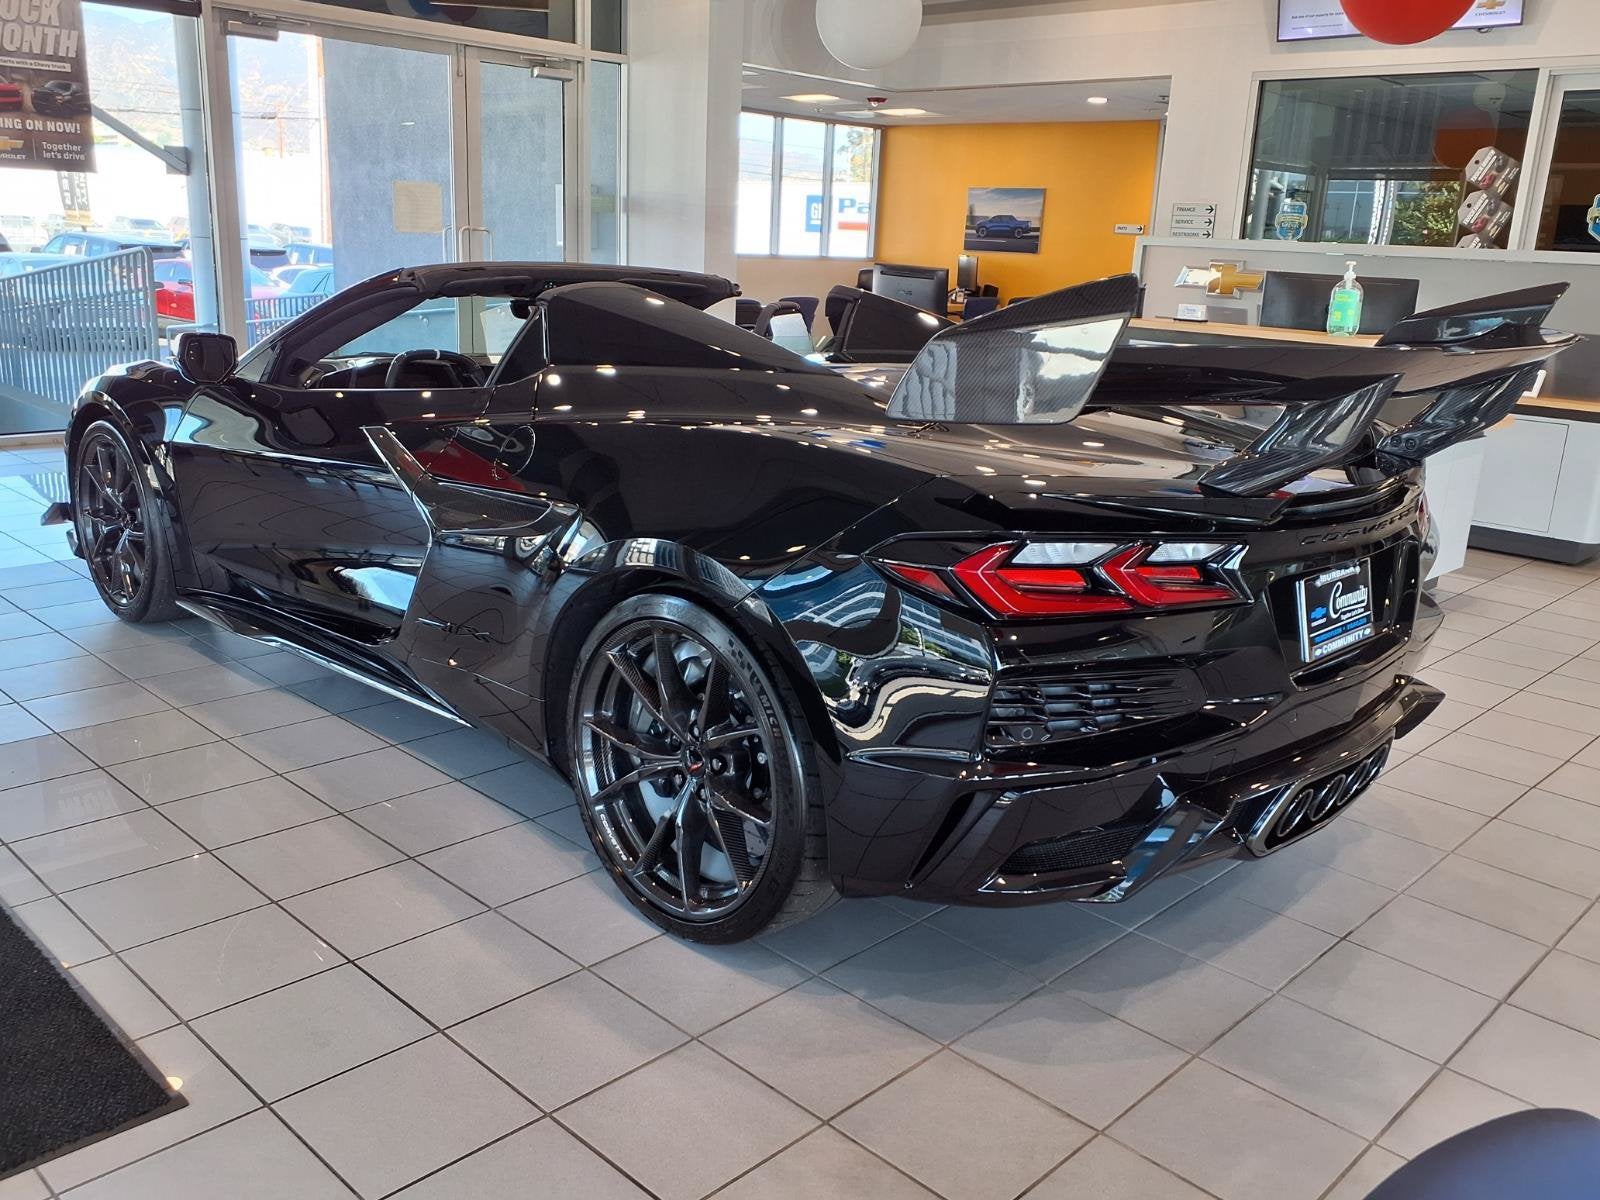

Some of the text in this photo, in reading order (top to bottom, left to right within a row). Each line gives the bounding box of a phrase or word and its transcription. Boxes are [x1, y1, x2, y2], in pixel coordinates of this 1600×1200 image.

[26, 120, 43, 130] ON
[47, 120, 80, 133] NOW!
[42, 141, 81, 152] Together
[43, 150, 61, 159] let's
[1329, 581, 1368, 619] Community
[1322, 629, 1364, 655] COMMUNITY
[600, 814, 628, 861] CORVETTE
